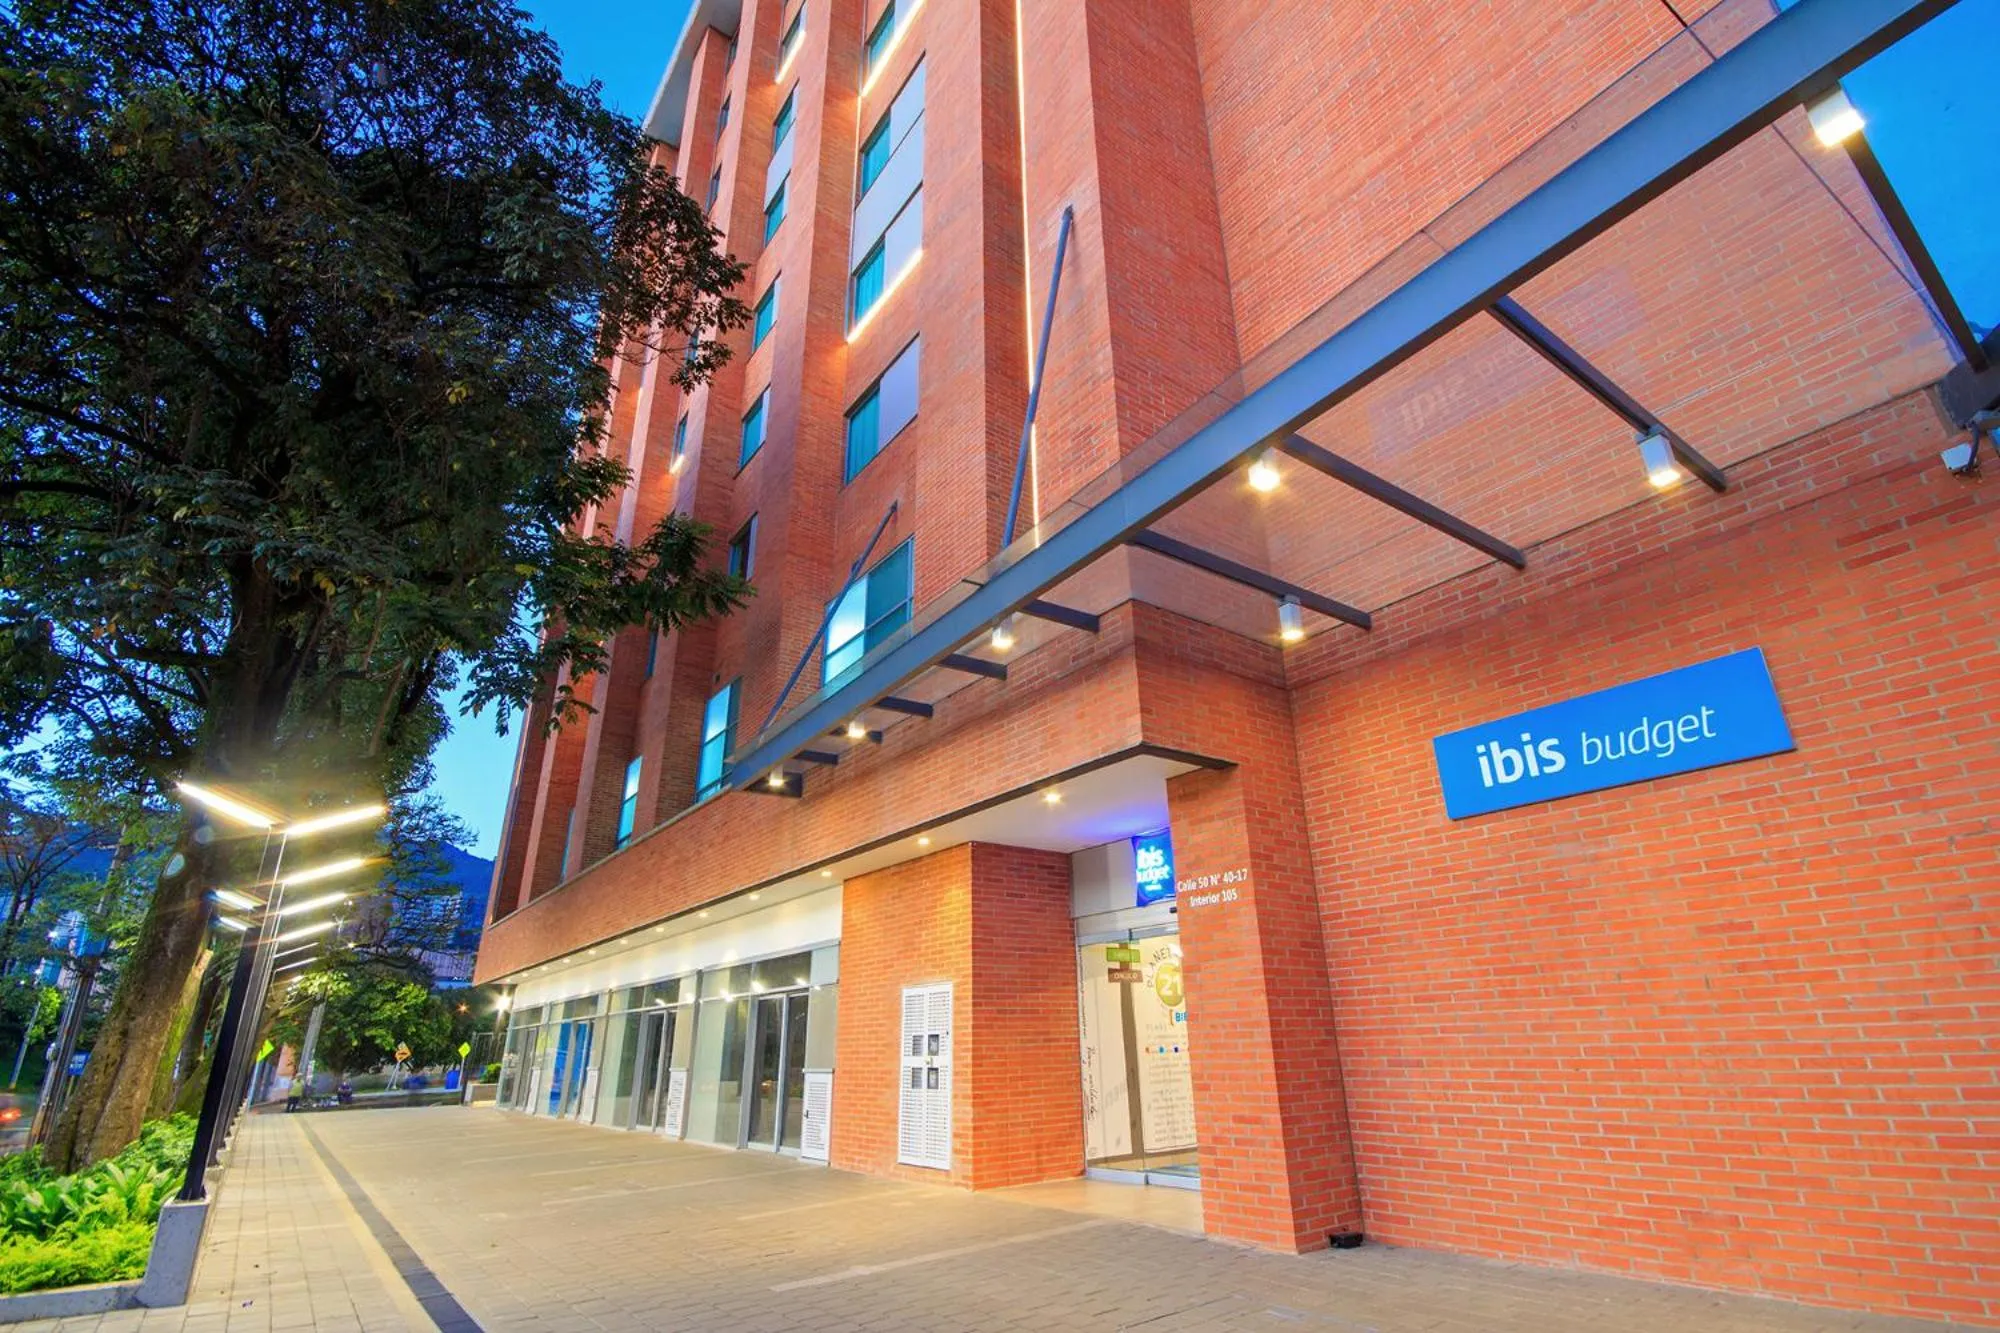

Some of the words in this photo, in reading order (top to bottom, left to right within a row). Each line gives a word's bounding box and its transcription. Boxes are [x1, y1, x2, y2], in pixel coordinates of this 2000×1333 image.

[1476, 732, 1567, 788] ibis
[1581, 705, 1717, 766] budget
[1177, 879, 1197, 893] Calle
[1198, 876, 1209, 889] 50
[1223, 868, 1248, 884] 40-17
[1190, 892, 1220, 907] Interior
[1222, 887, 1238, 902] 105
[1160, 972, 1181, 998] 21
